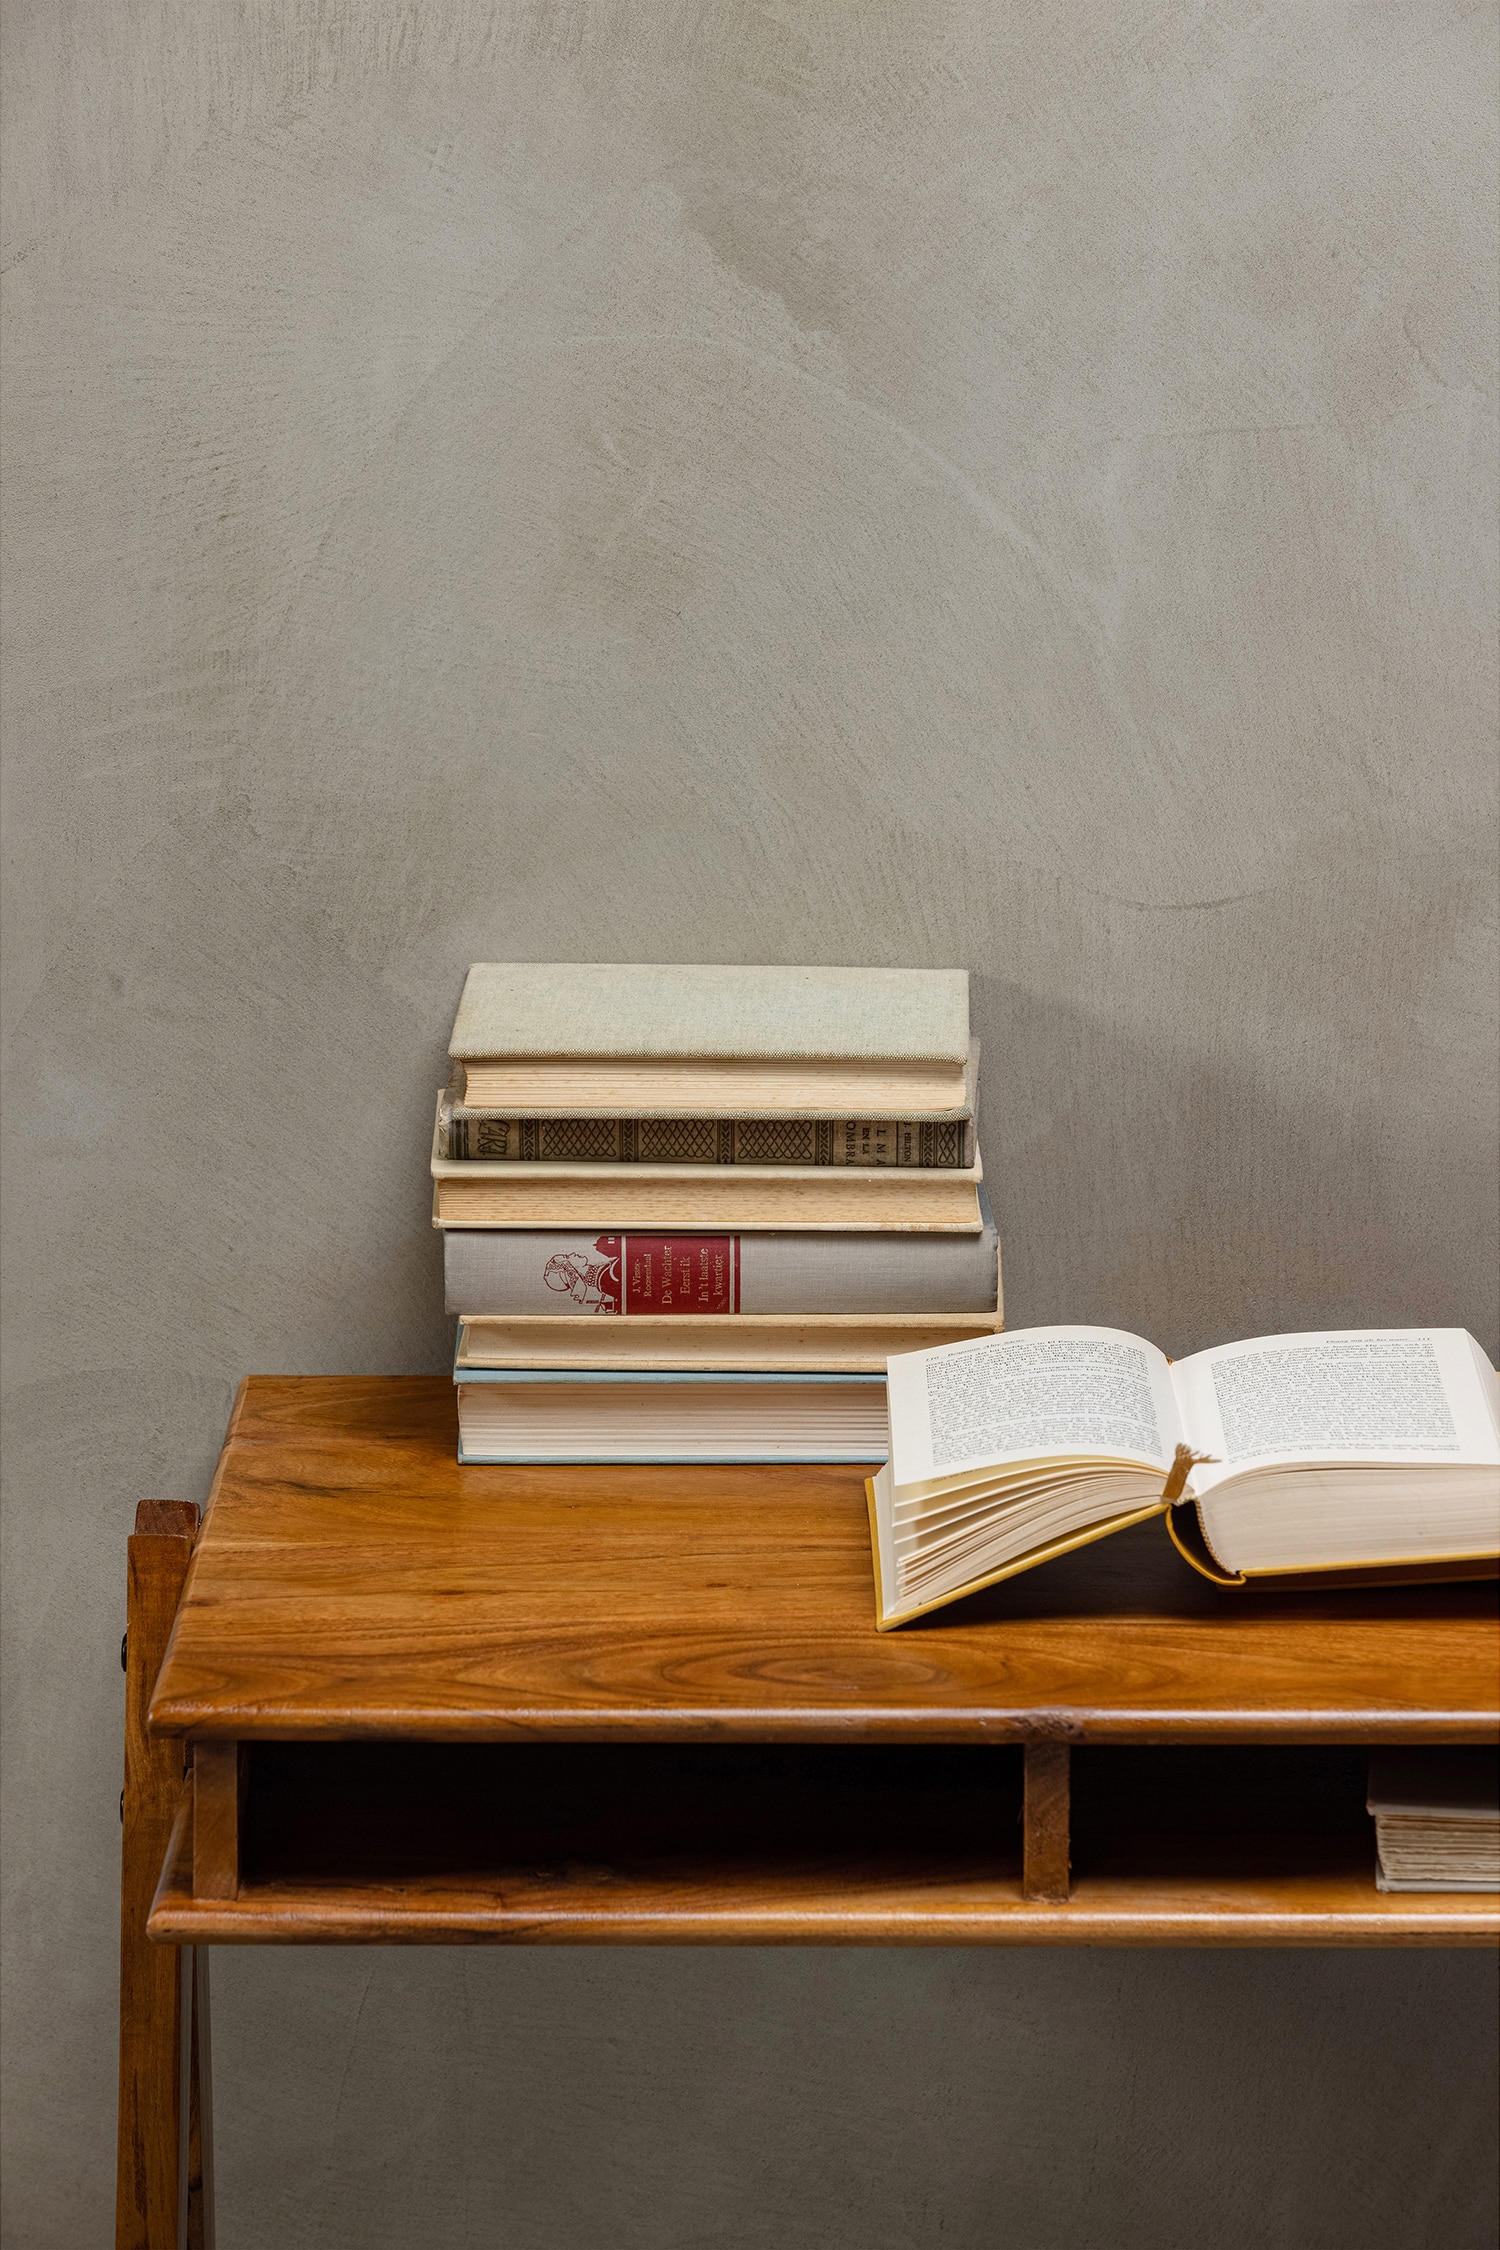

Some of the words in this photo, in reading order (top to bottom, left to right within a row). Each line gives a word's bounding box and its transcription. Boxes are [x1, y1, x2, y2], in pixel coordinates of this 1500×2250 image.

[845, 1121, 857, 1165] OMBRA
[862, 1127, 870, 1140] EN
[876, 1120, 887, 1166] LMA
[904, 1132, 912, 1162] HILTON
[862, 1143, 870, 1155] LA
[643, 1253, 652, 1297] Roosendaal
[662, 1245, 673, 1288] Wachter
[680, 1256, 691, 1267] ik
[700, 1248, 709, 1281] laatste
[713, 1254, 724, 1296] kwartier
[632, 1285, 641, 1294] J.
[680, 1267, 691, 1294] Eerst
[662, 1290, 673, 1304] De
[698, 1290, 709, 1302] In
